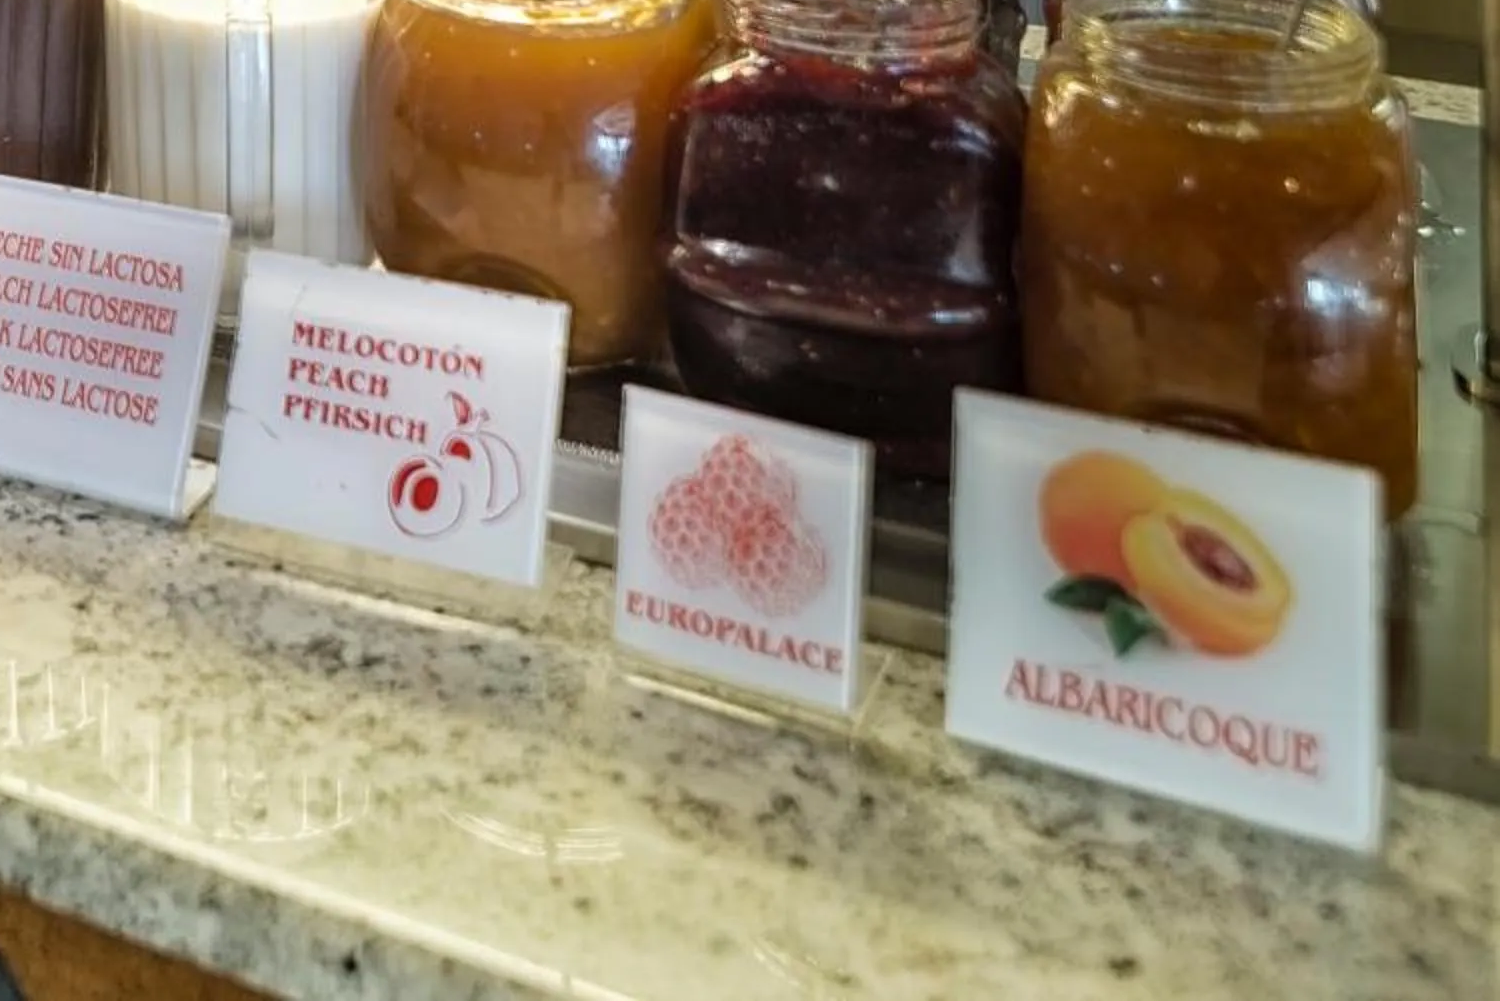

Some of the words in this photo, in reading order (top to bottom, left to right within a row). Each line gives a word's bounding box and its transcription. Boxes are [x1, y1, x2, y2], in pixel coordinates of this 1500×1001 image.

[48, 240, 86, 272] SIN
[88, 249, 185, 292] LACTOSA
[37, 282, 179, 337] LACTOSEFREI
[18, 323, 164, 379] LACTOSEFREE
[288, 357, 390, 399] PEACH
[1, 365, 56, 401] SANS
[60, 378, 159, 425] LACTOSE
[283, 394, 429, 444] PFIRSICH
[625, 590, 843, 674] EUROPALACE
[1003, 658, 1320, 776] ALBARICOQUE
